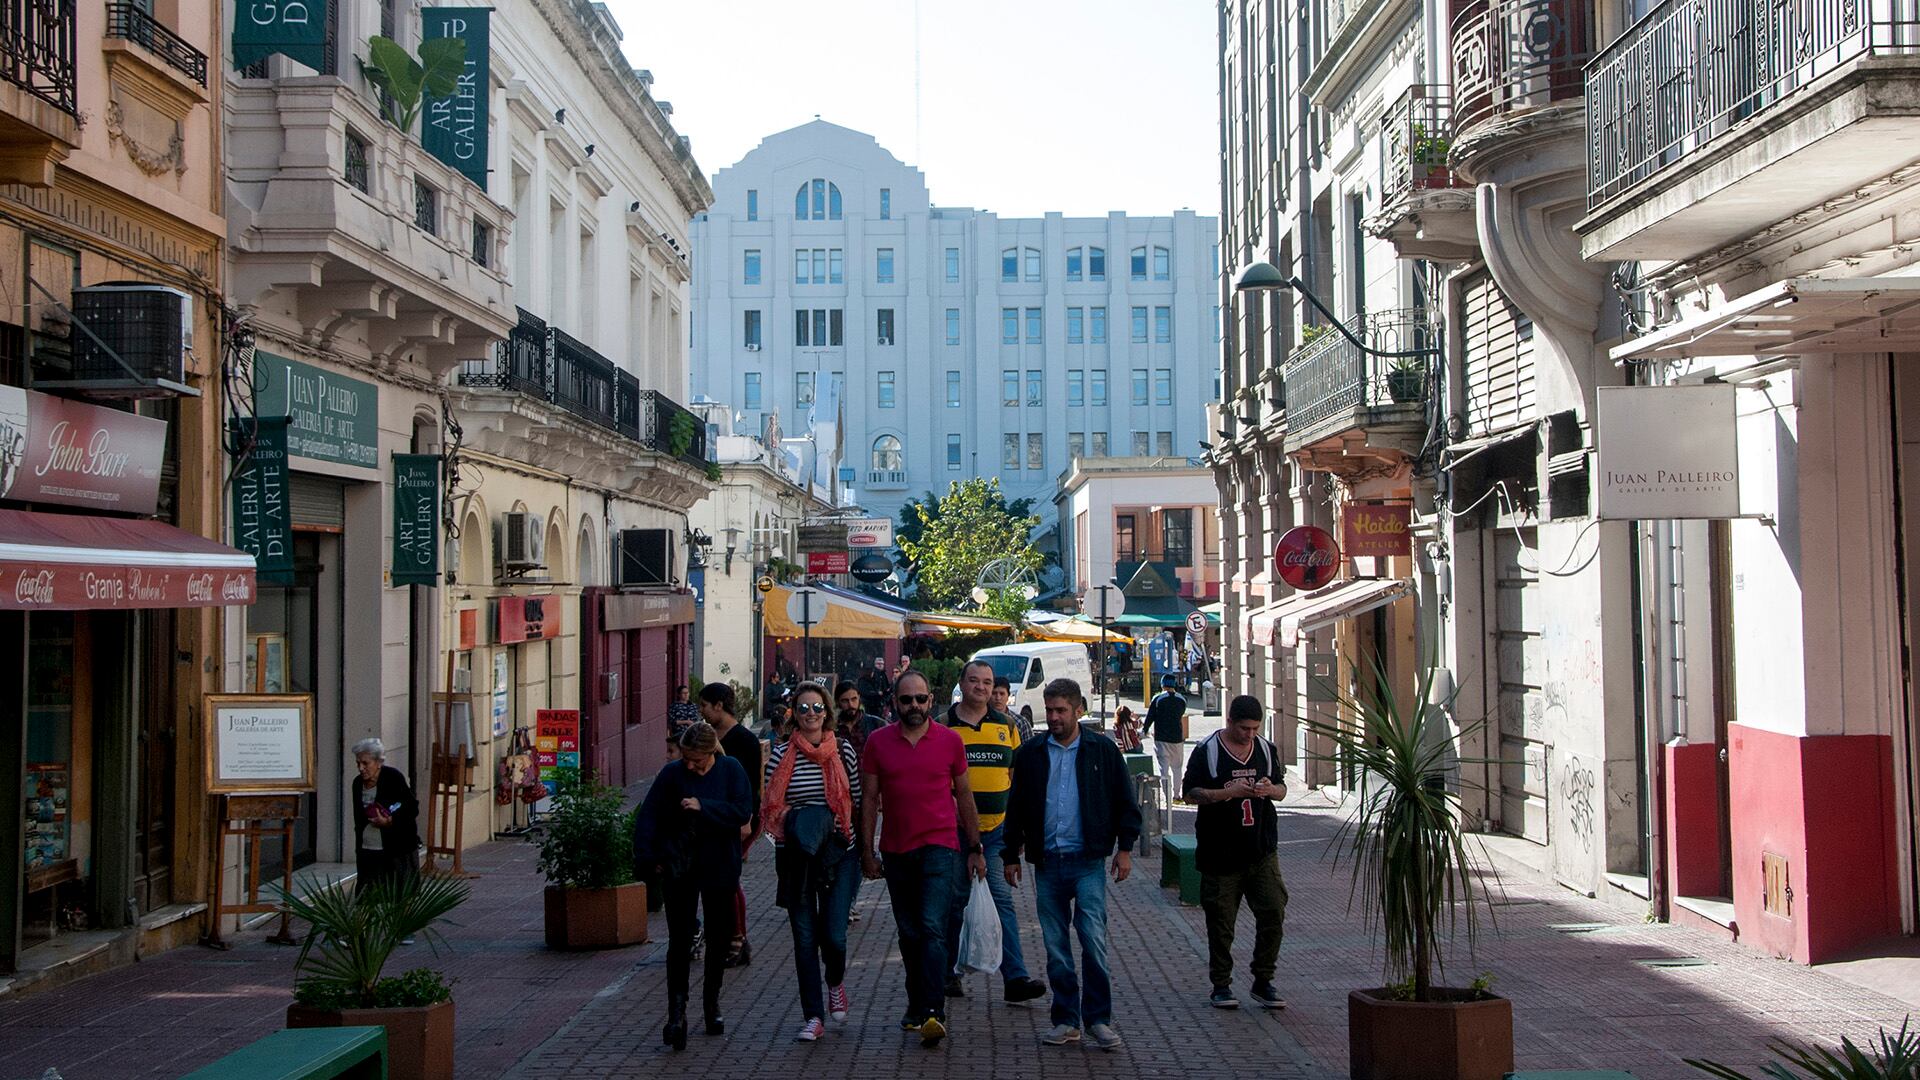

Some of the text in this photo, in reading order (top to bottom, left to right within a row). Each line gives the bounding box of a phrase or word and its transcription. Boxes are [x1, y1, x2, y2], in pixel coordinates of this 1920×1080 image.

[250, 0, 277, 25] G
[431, 98, 450, 131] AR
[285, 366, 358, 416] JUAN PALLEIRO
[291, 408, 354, 439] GALERIA DE ARTE
[35, 421, 129, 478] John Barr
[398, 475, 435, 488] PALLEIRO
[409, 467, 427, 478] JUAN
[1607, 470, 1734, 486] JUAN PALLEIRO
[264, 465, 284, 556] DE ARTE
[400, 518, 413, 551] ART
[417, 494, 431, 564] GALLERY
[1353, 513, 1406, 535] Heide
[1359, 541, 1400, 549] ATELIER
[229, 715, 289, 731] JUAN PALLEIRO
[542, 727, 574, 736] SALE
[966, 752, 1003, 760] INGSTON
[1241, 799, 1254, 826] 1
